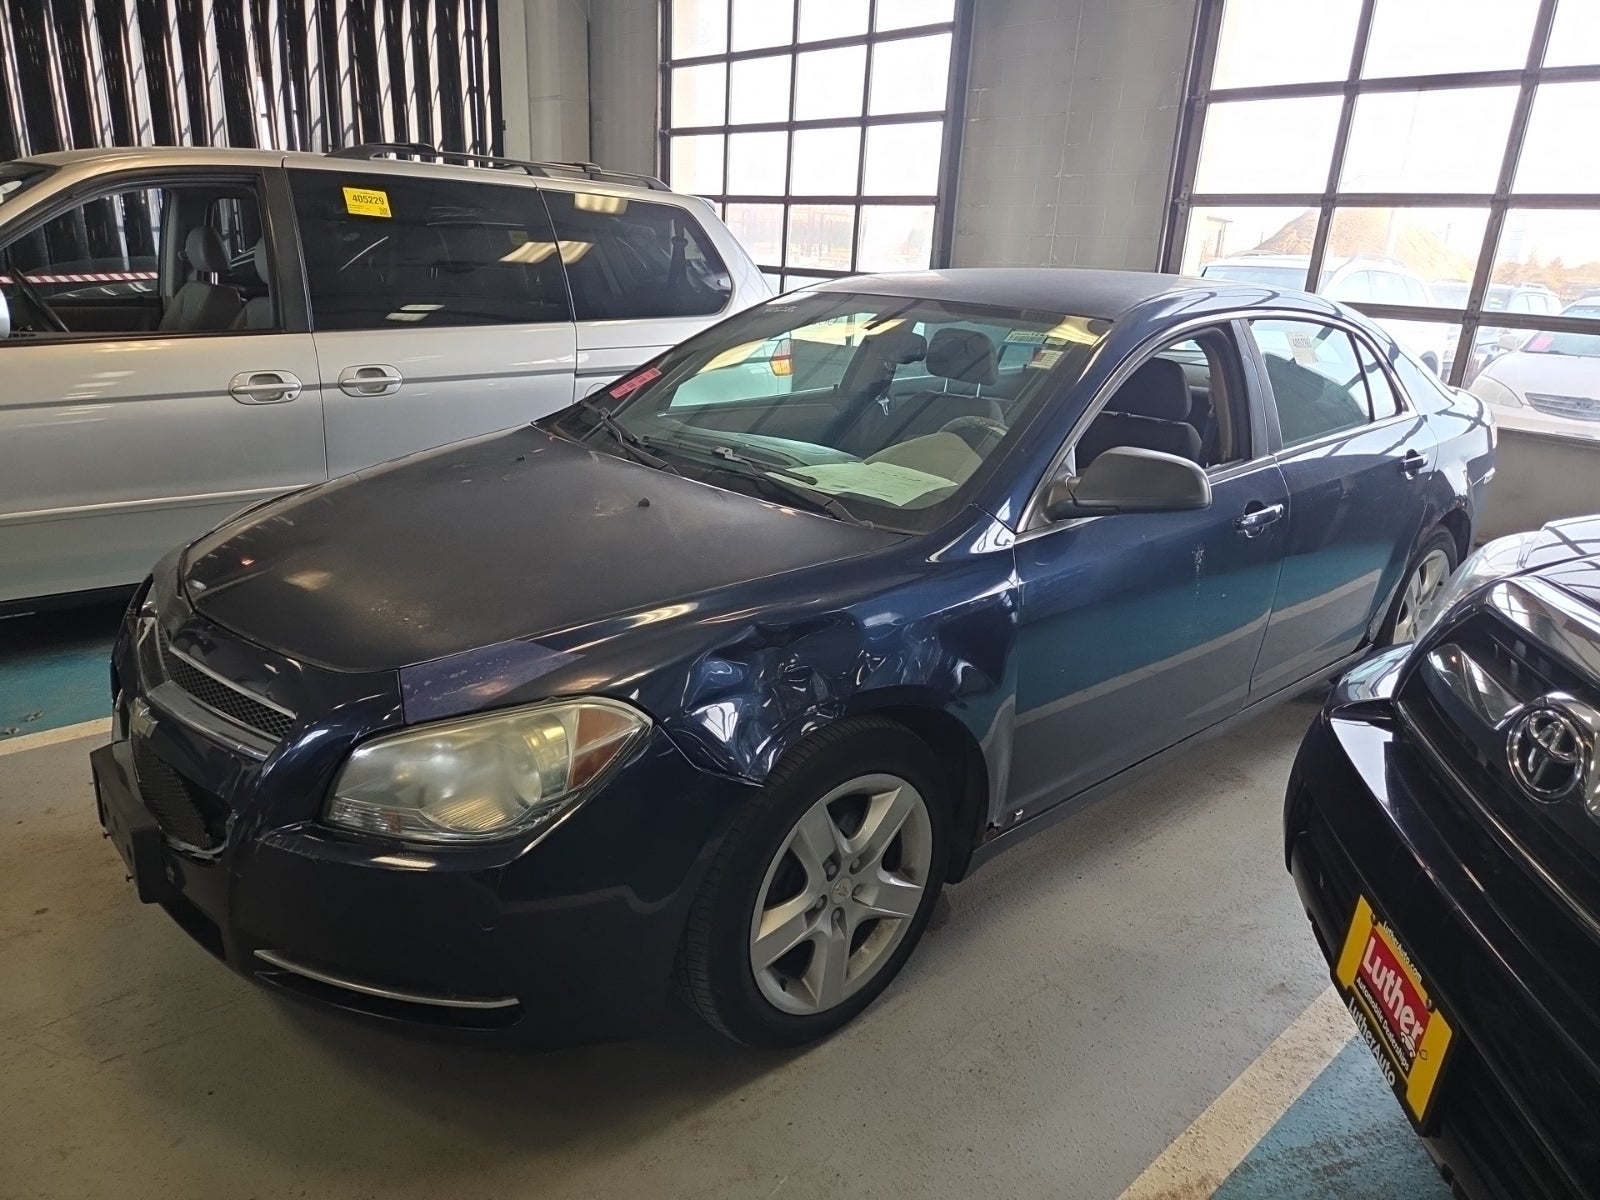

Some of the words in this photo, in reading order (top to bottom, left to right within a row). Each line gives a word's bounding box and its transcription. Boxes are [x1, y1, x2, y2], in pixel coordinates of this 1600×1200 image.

[352, 194, 385, 205] 405229
[1356, 977, 1383, 1022] Automobile
[1382, 1021, 1410, 1071] Dealerships
[1362, 936, 1424, 1040] Luther
